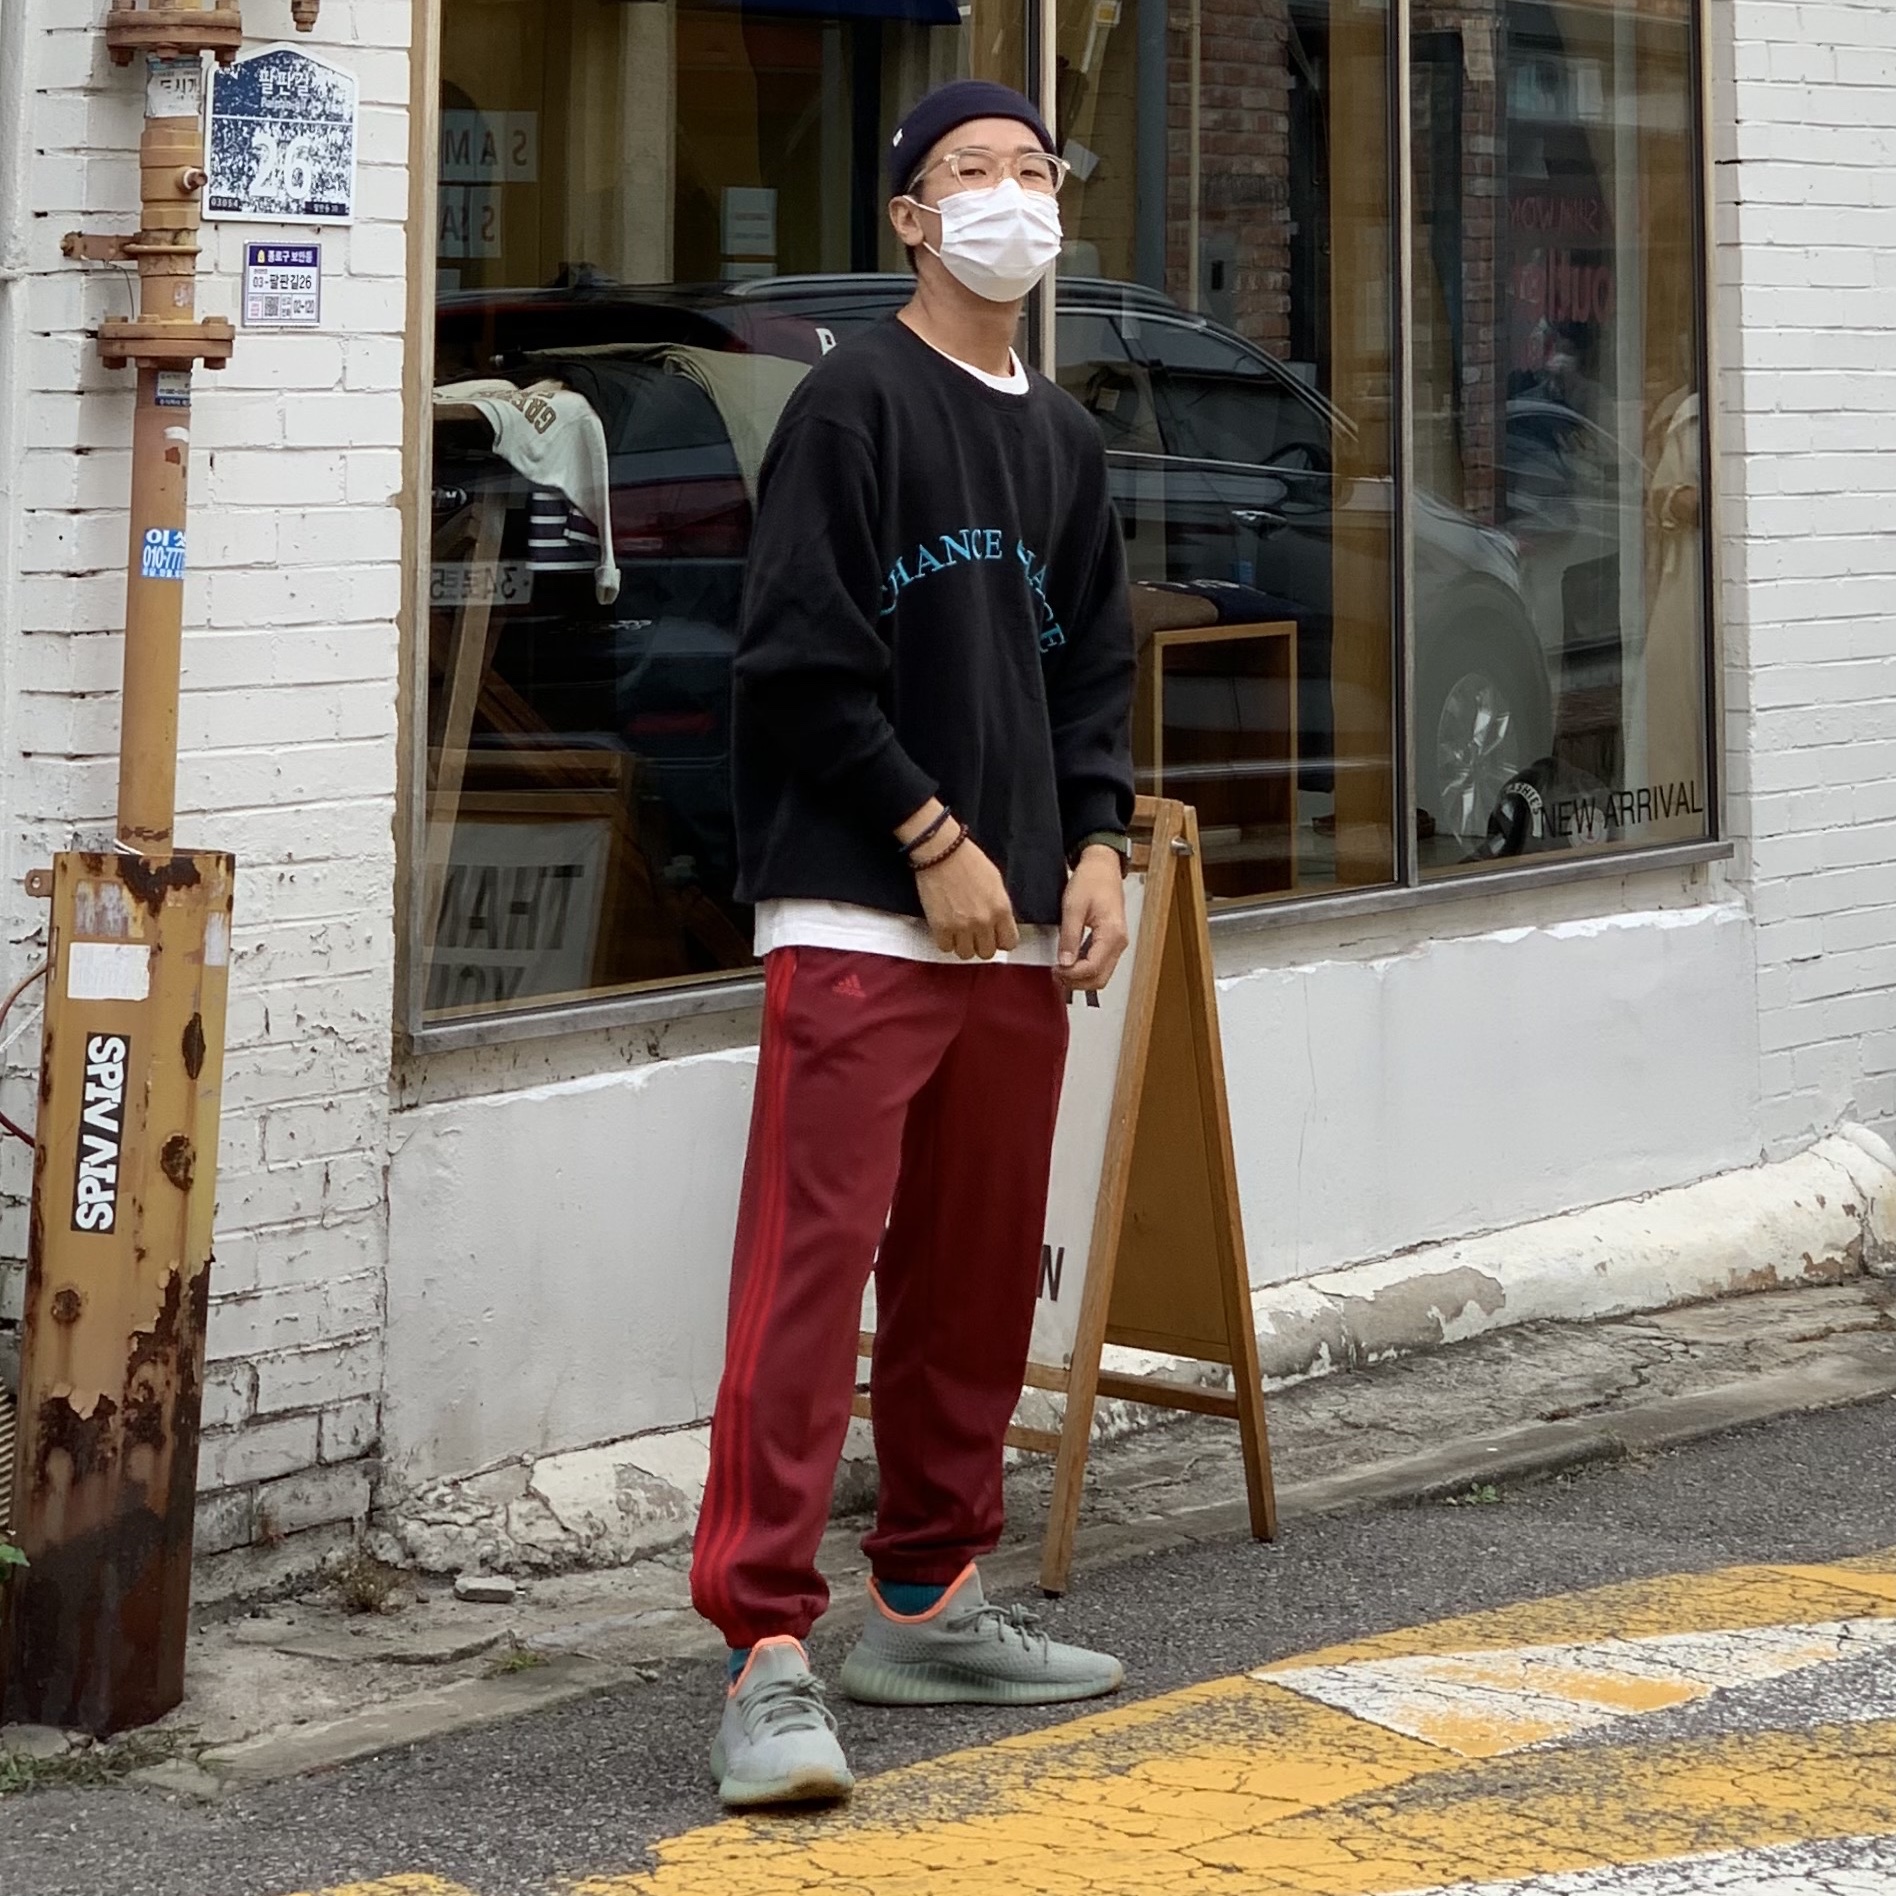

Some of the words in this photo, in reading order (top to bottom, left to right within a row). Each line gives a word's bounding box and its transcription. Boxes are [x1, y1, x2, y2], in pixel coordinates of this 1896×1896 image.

[250, 133, 312, 199] 26
[1540, 797, 1596, 840] NEW
[1603, 779, 1704, 829] ARRIVAL
